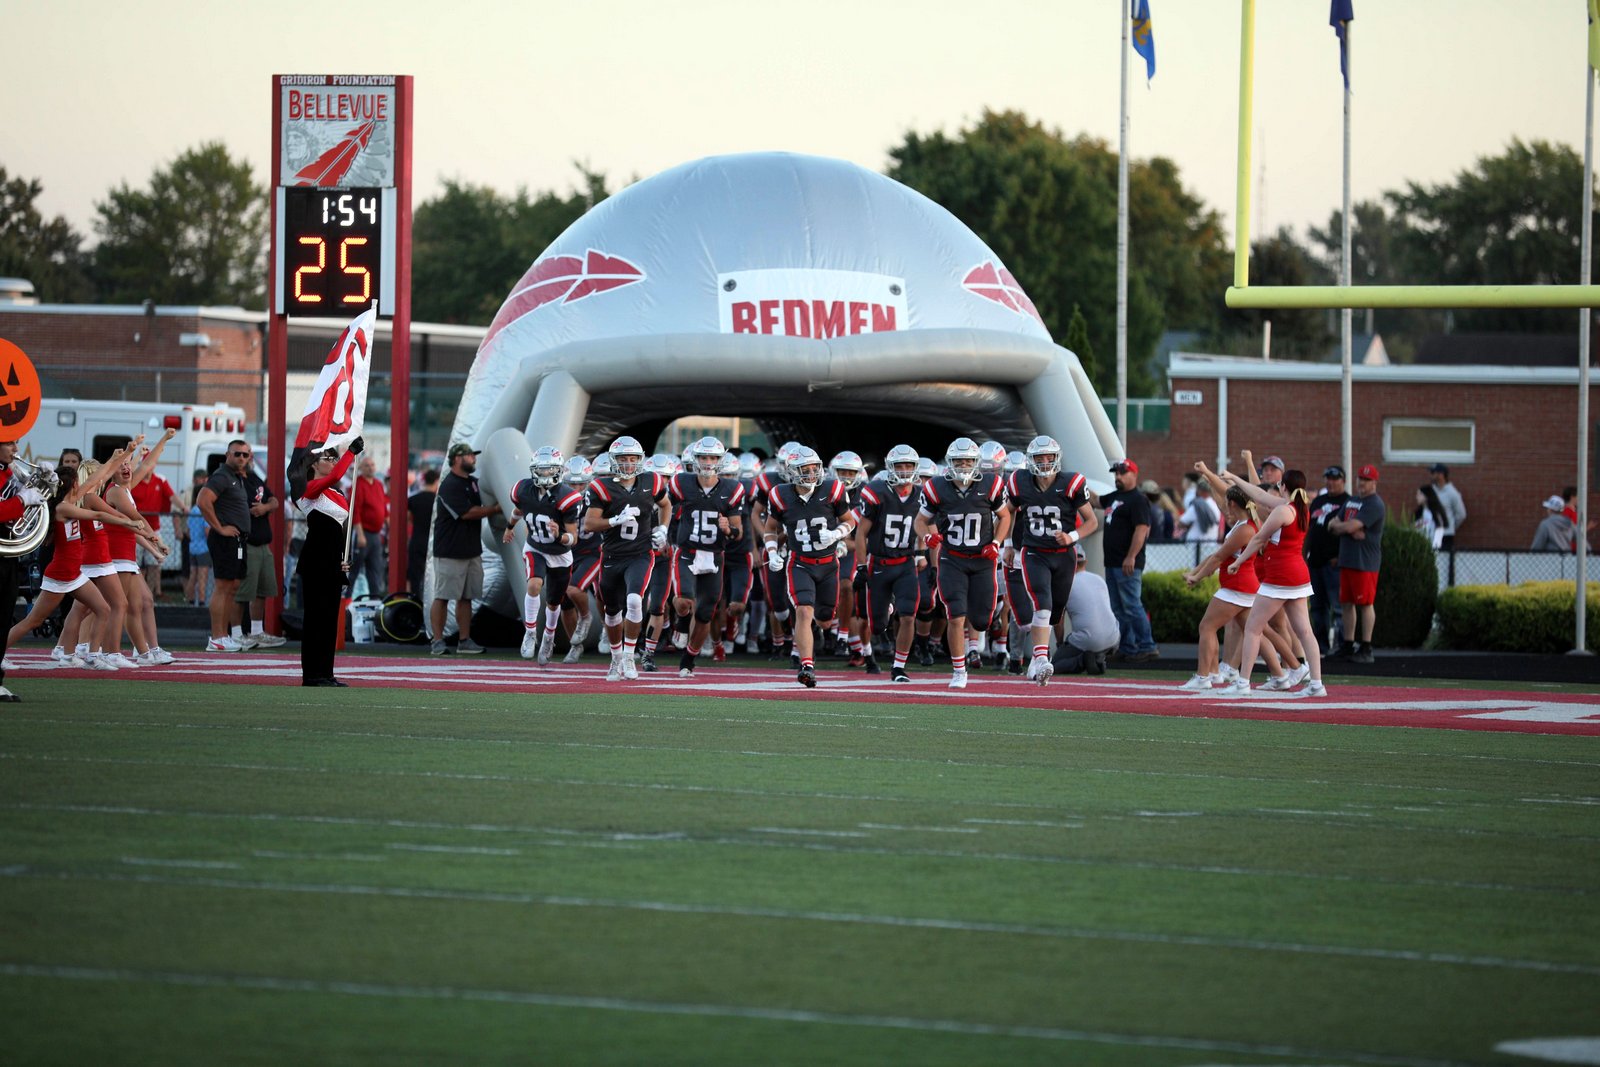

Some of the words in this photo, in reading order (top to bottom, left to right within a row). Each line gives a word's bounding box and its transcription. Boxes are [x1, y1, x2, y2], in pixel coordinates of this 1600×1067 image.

[281, 75, 326, 85] GRIDIRON
[333, 75, 395, 85] FOUNDATION
[289, 90, 388, 120] BELLEVUE
[322, 195, 377, 226] 1:54
[295, 237, 370, 303] 25
[732, 299, 896, 340] REDMEN
[525, 512, 555, 544] 10
[620, 506, 641, 541] 6
[689, 509, 719, 545] 15
[795, 516, 832, 552] 43
[884, 514, 913, 548] 51
[947, 513, 982, 547] 50
[1027, 505, 1063, 537] 63
